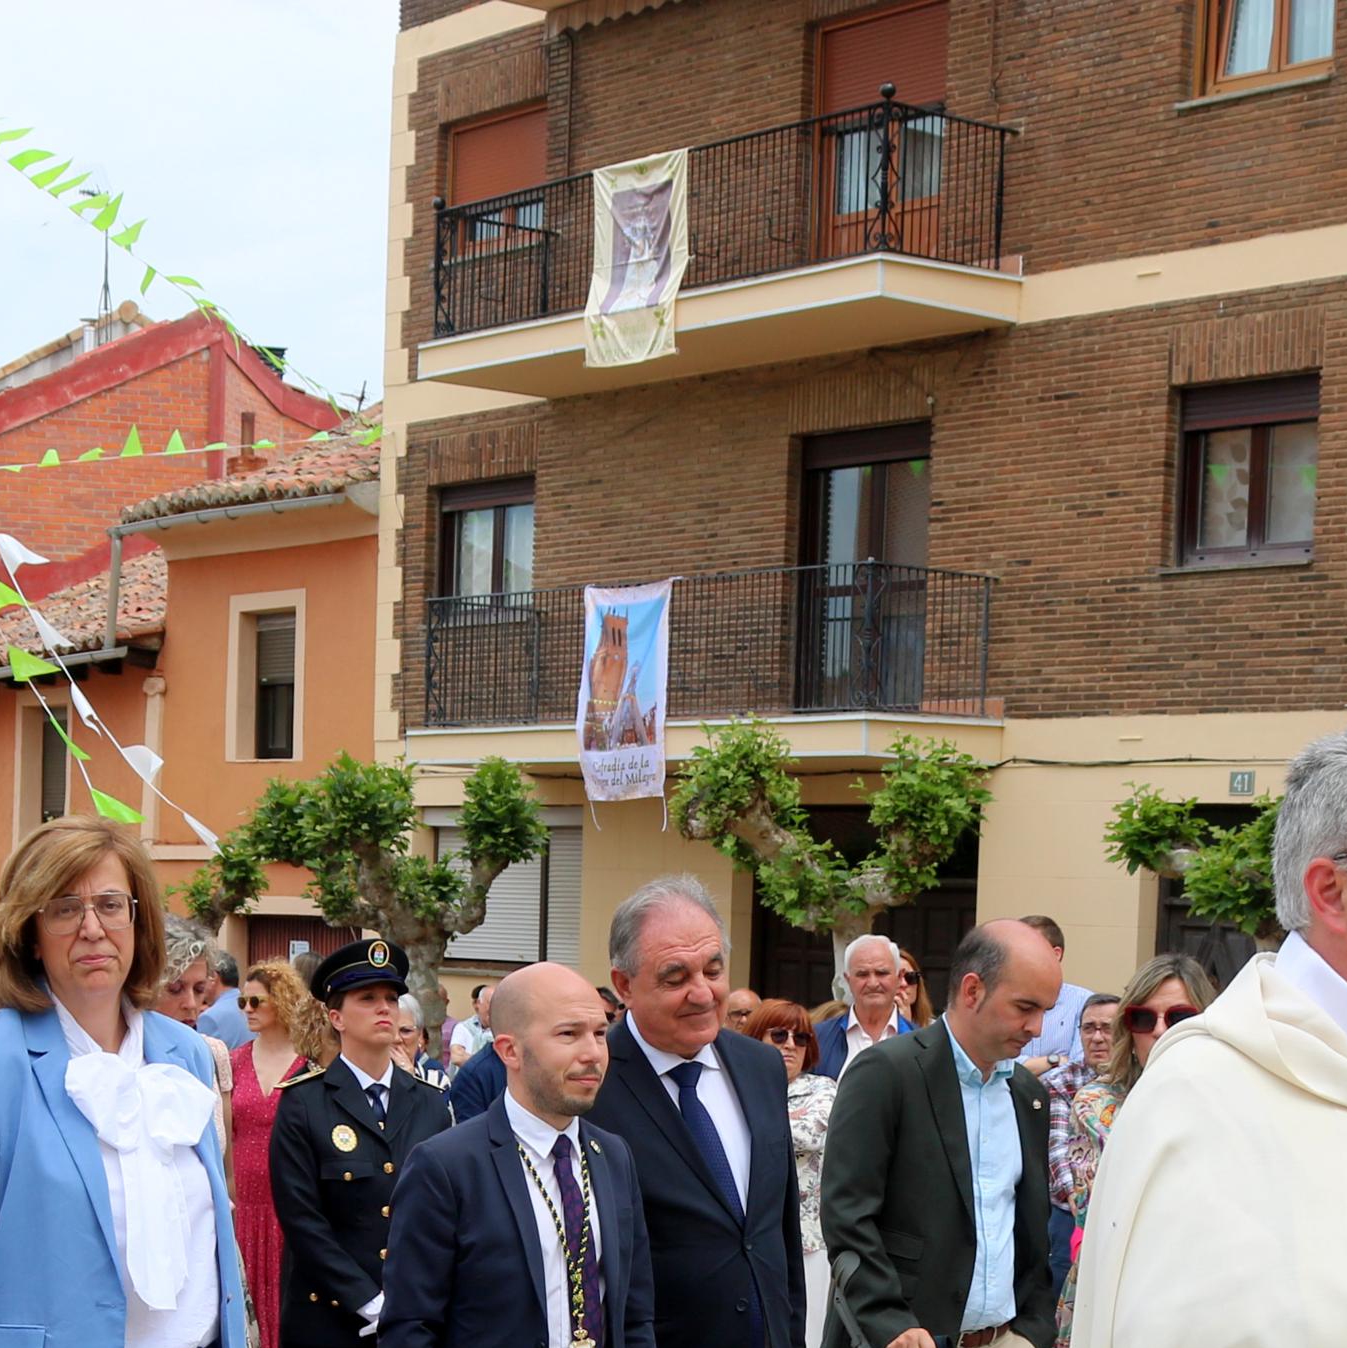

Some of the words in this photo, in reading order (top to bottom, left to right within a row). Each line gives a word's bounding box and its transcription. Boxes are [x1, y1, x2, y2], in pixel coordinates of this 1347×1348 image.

[628, 755, 638, 769] de
[640, 753, 650, 768] la
[611, 771, 623, 785] del
[1233, 774, 1249, 792] 41
